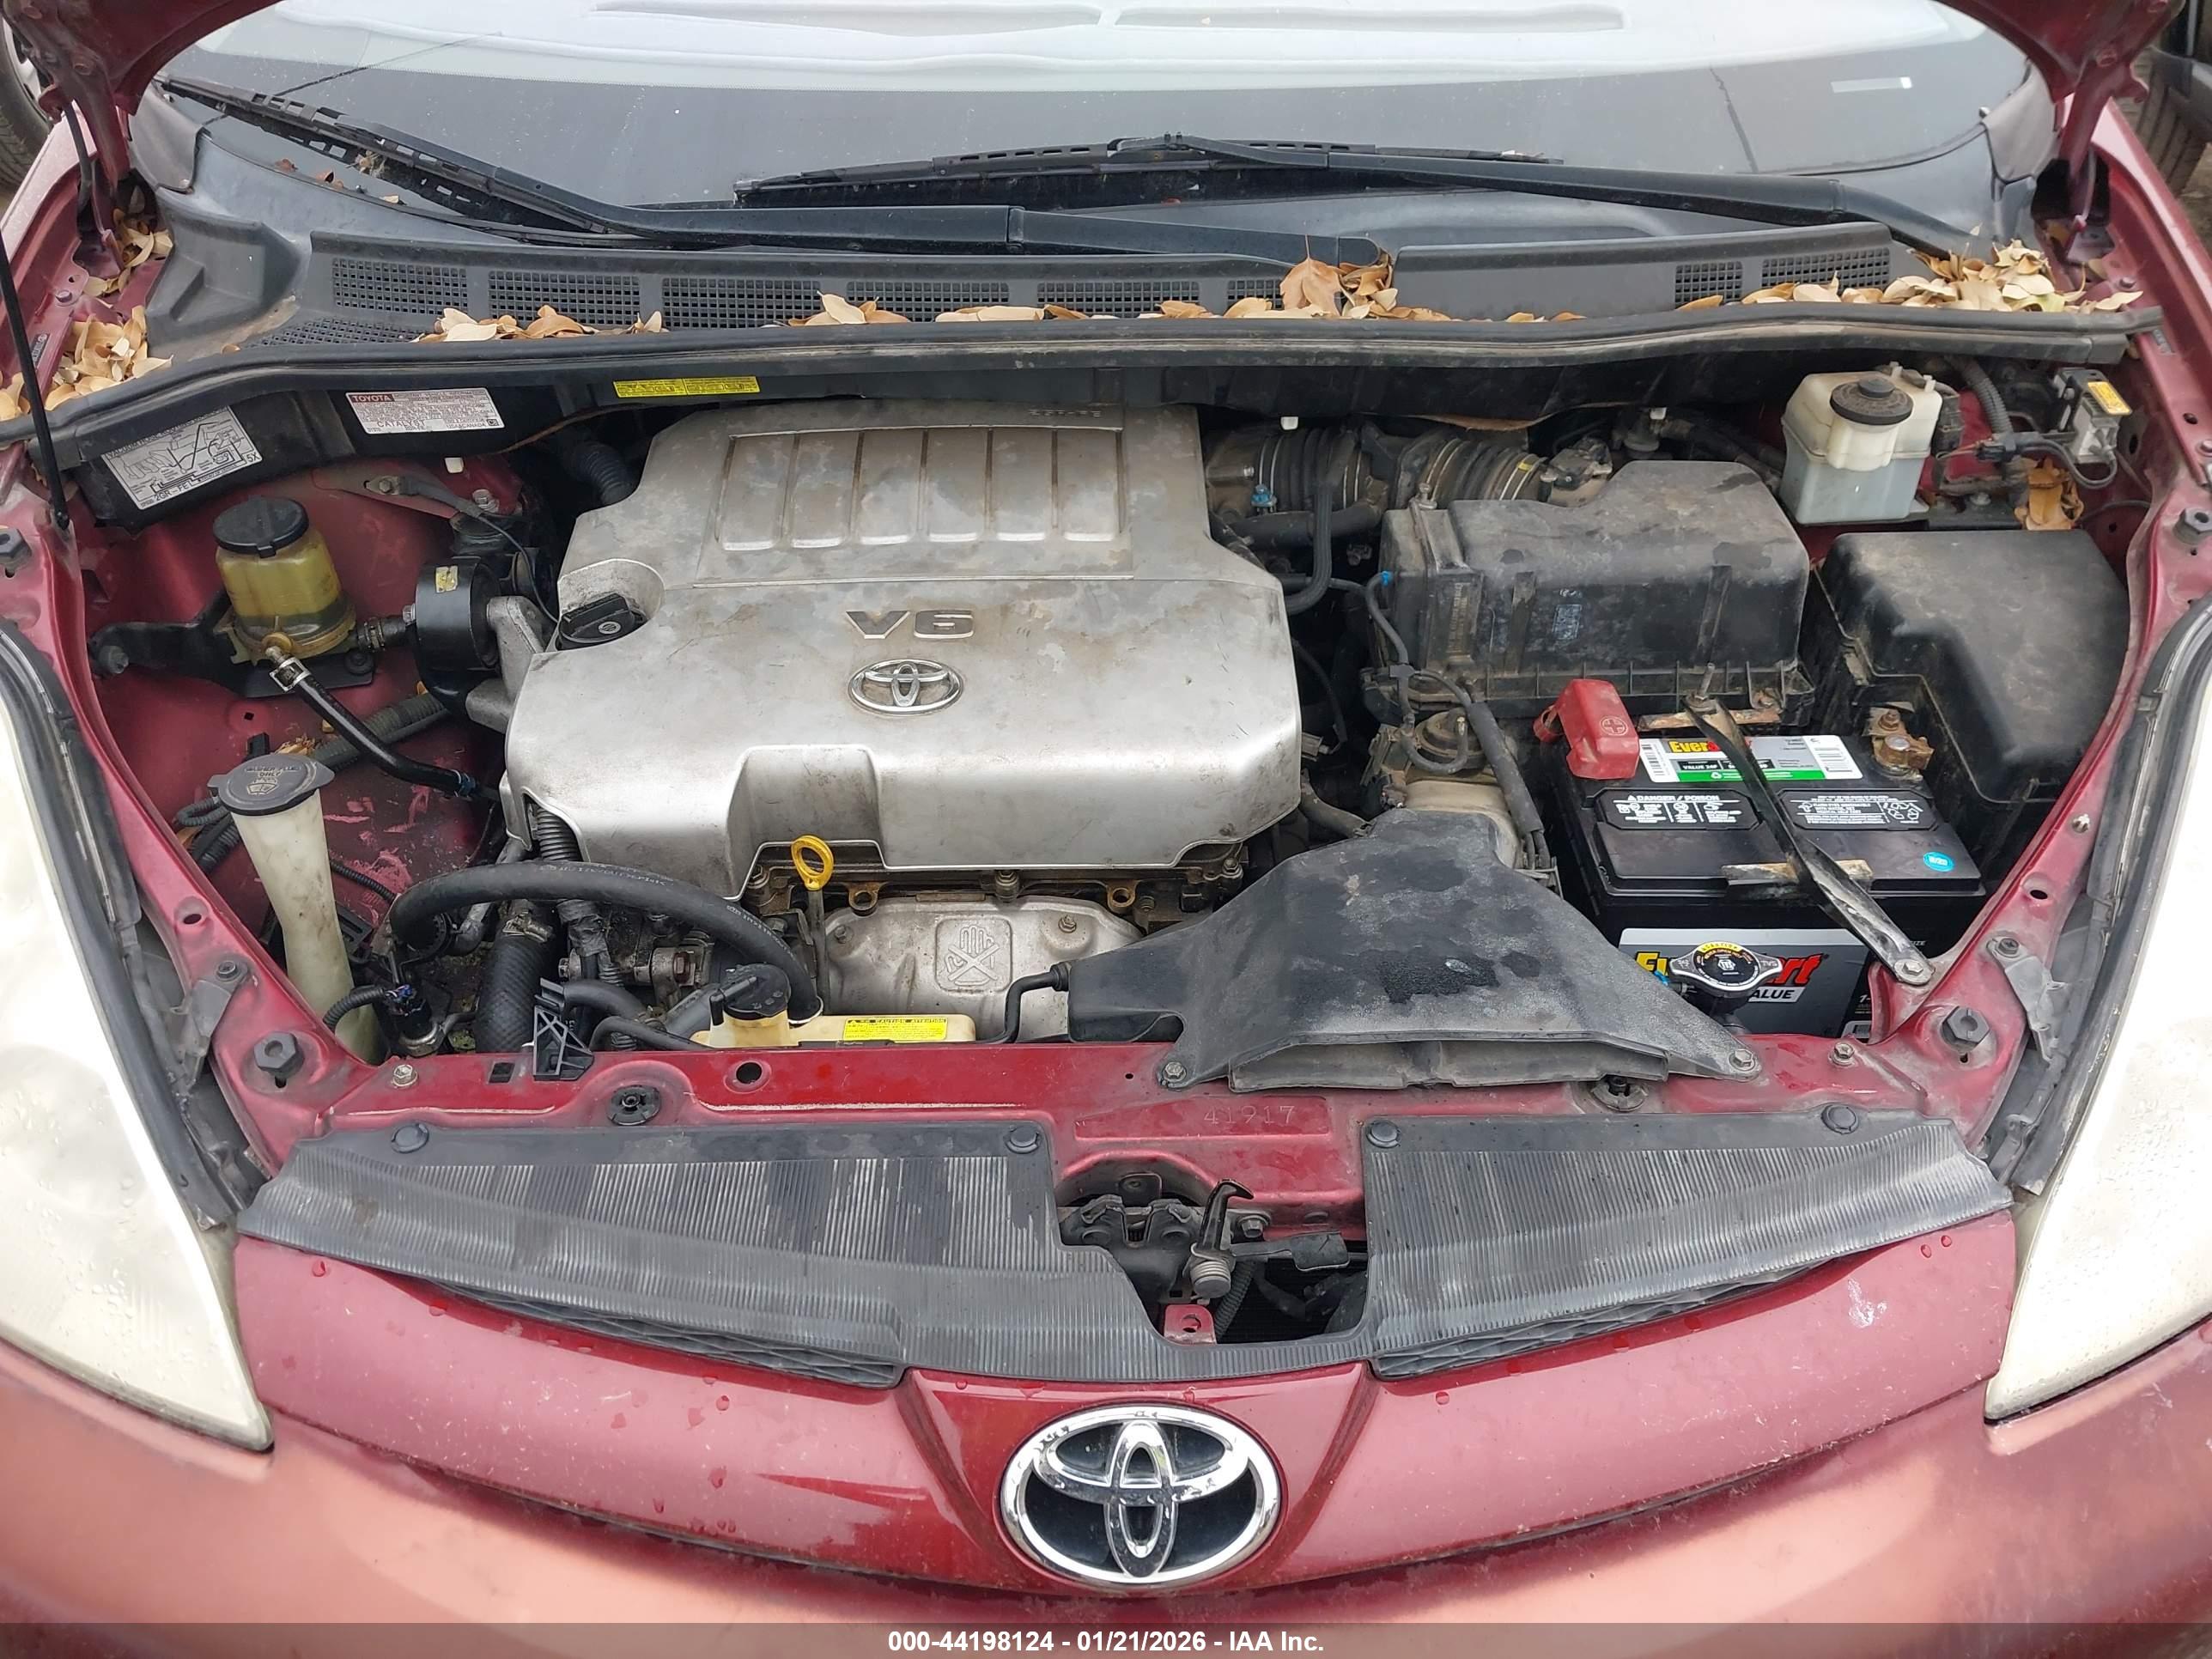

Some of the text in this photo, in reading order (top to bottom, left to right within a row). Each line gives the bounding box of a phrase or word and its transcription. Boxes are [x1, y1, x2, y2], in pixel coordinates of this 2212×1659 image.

[246, 452, 261, 463] 5X
[846, 610, 974, 639] V6
[1751, 989, 1794, 1000] ALUE
